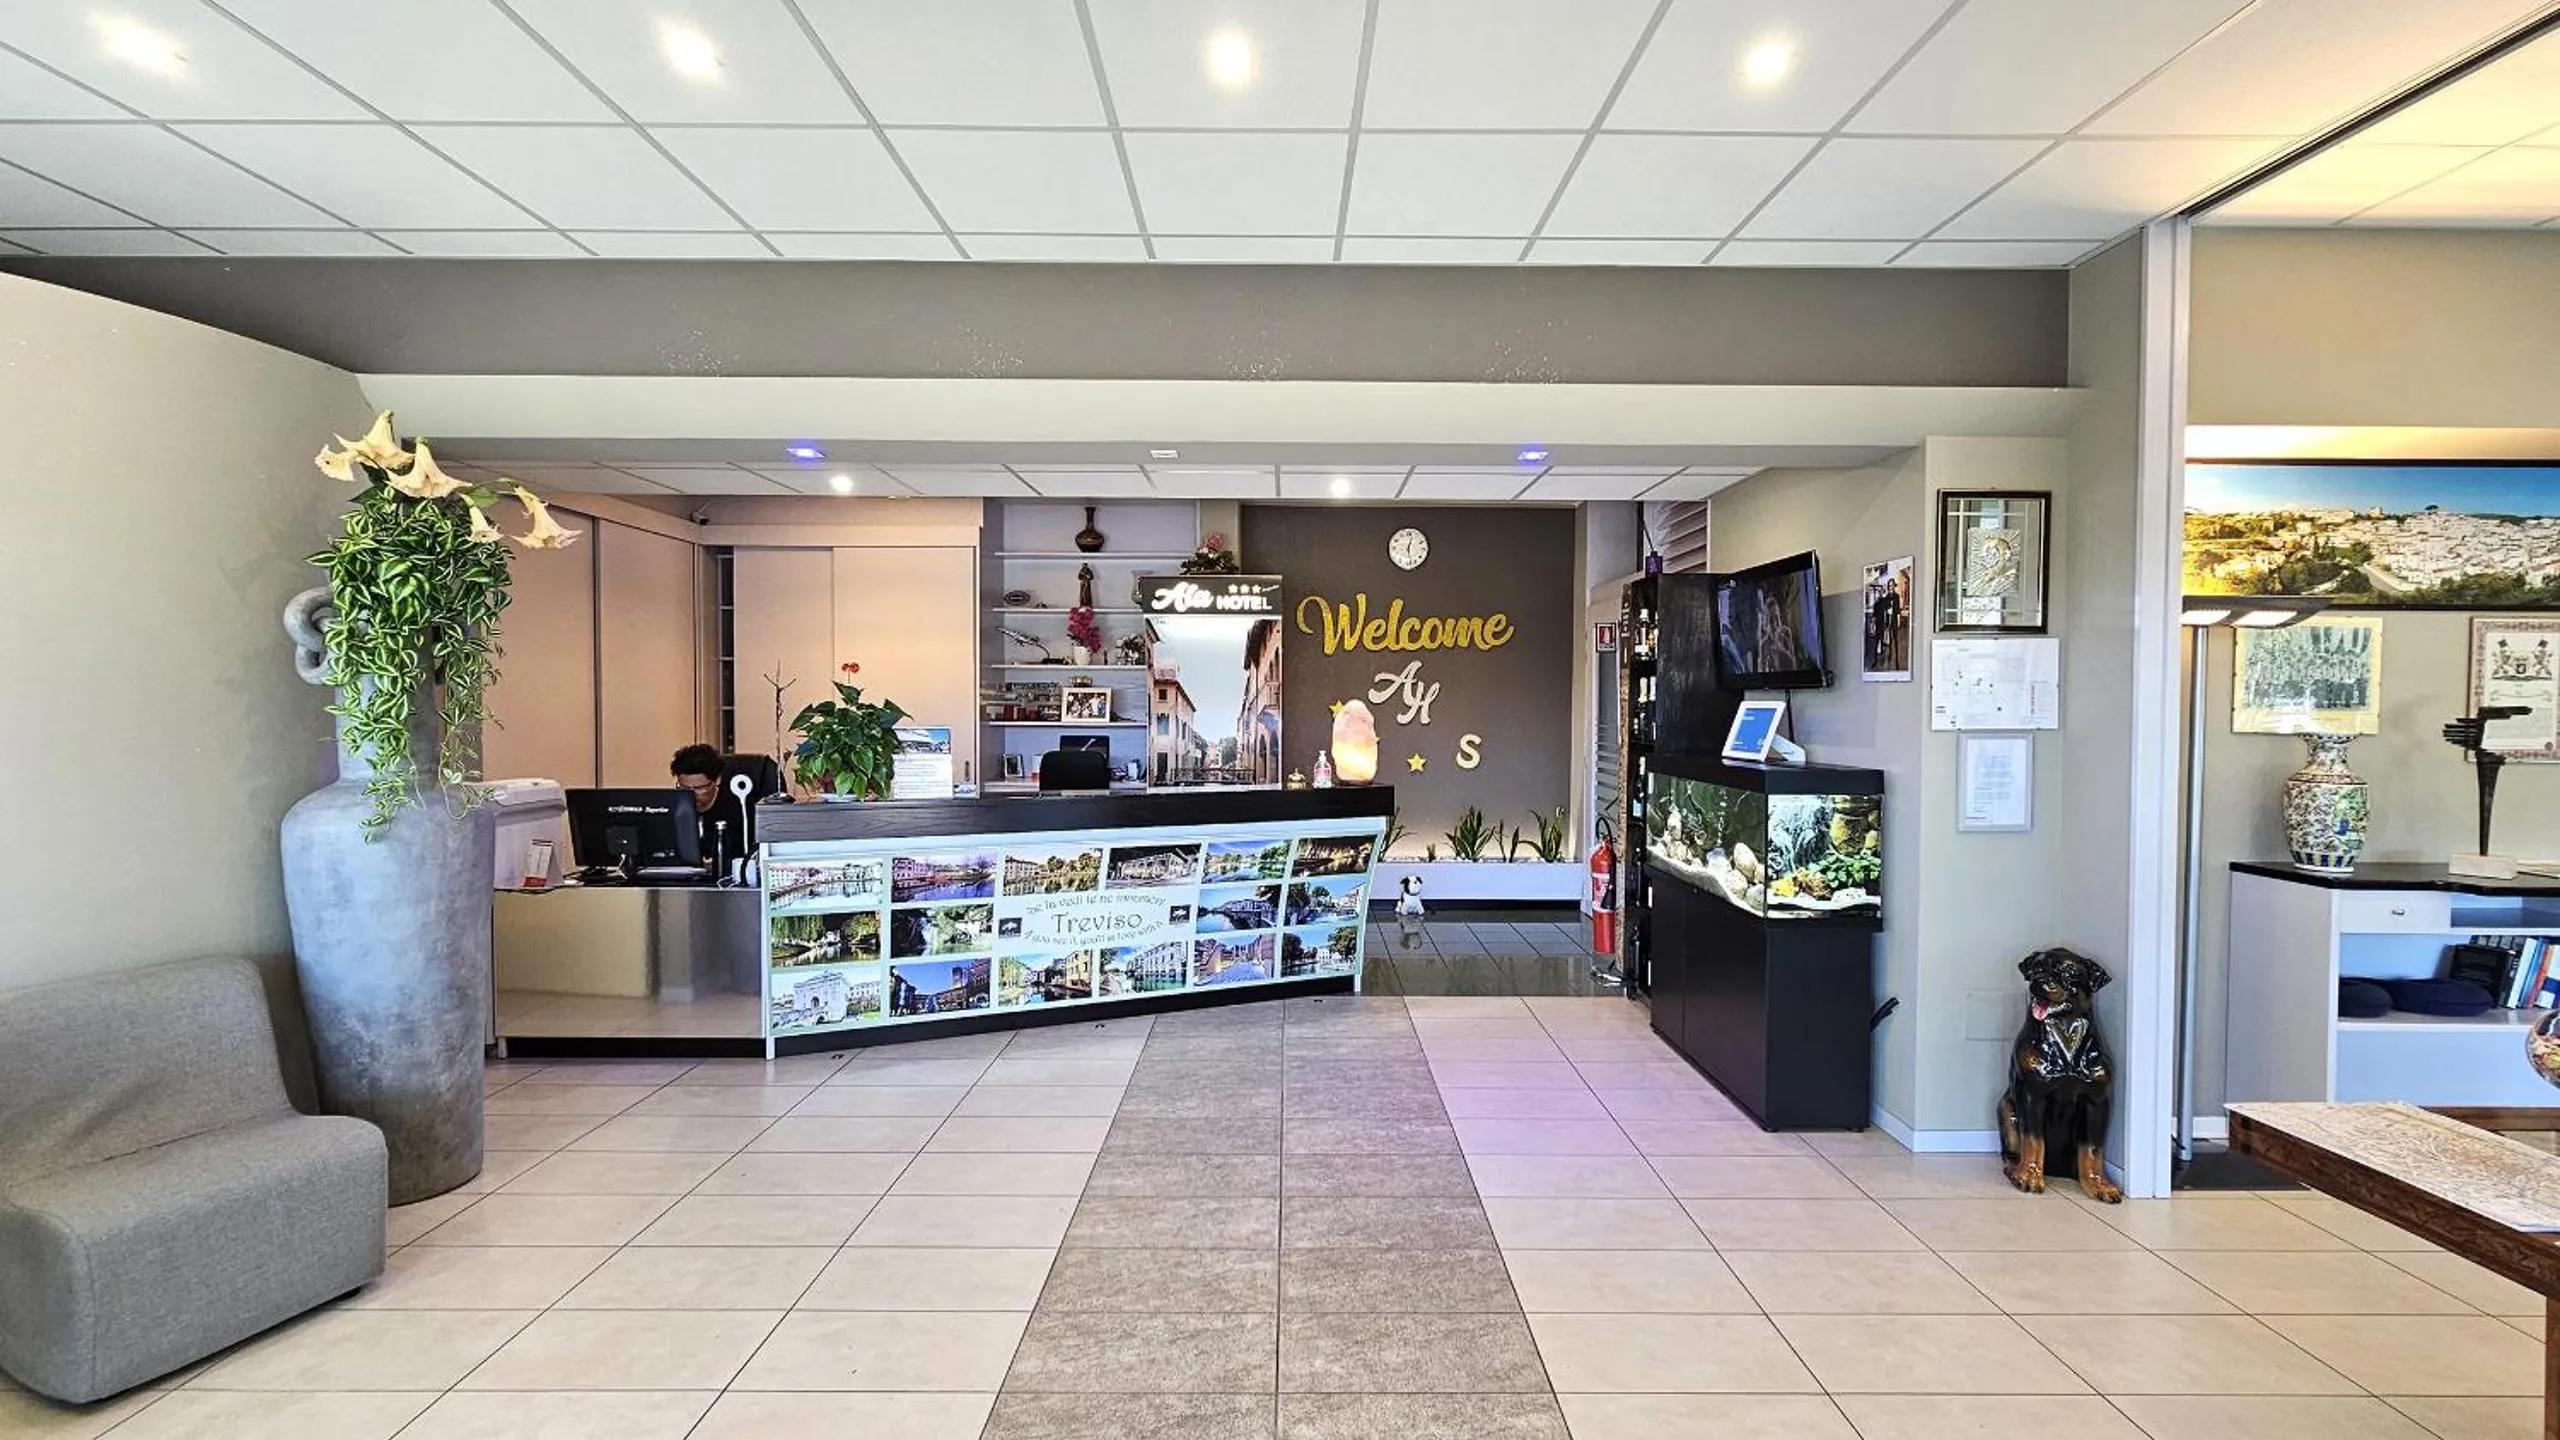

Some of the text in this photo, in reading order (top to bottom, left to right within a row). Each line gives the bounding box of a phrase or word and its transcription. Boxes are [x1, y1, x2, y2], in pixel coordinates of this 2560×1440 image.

[1152, 581, 1273, 612] Ala HOTEL
[1296, 593, 1515, 656] Welcome
[1456, 733, 1482, 769] S
[1051, 911, 1143, 936] Treviso
